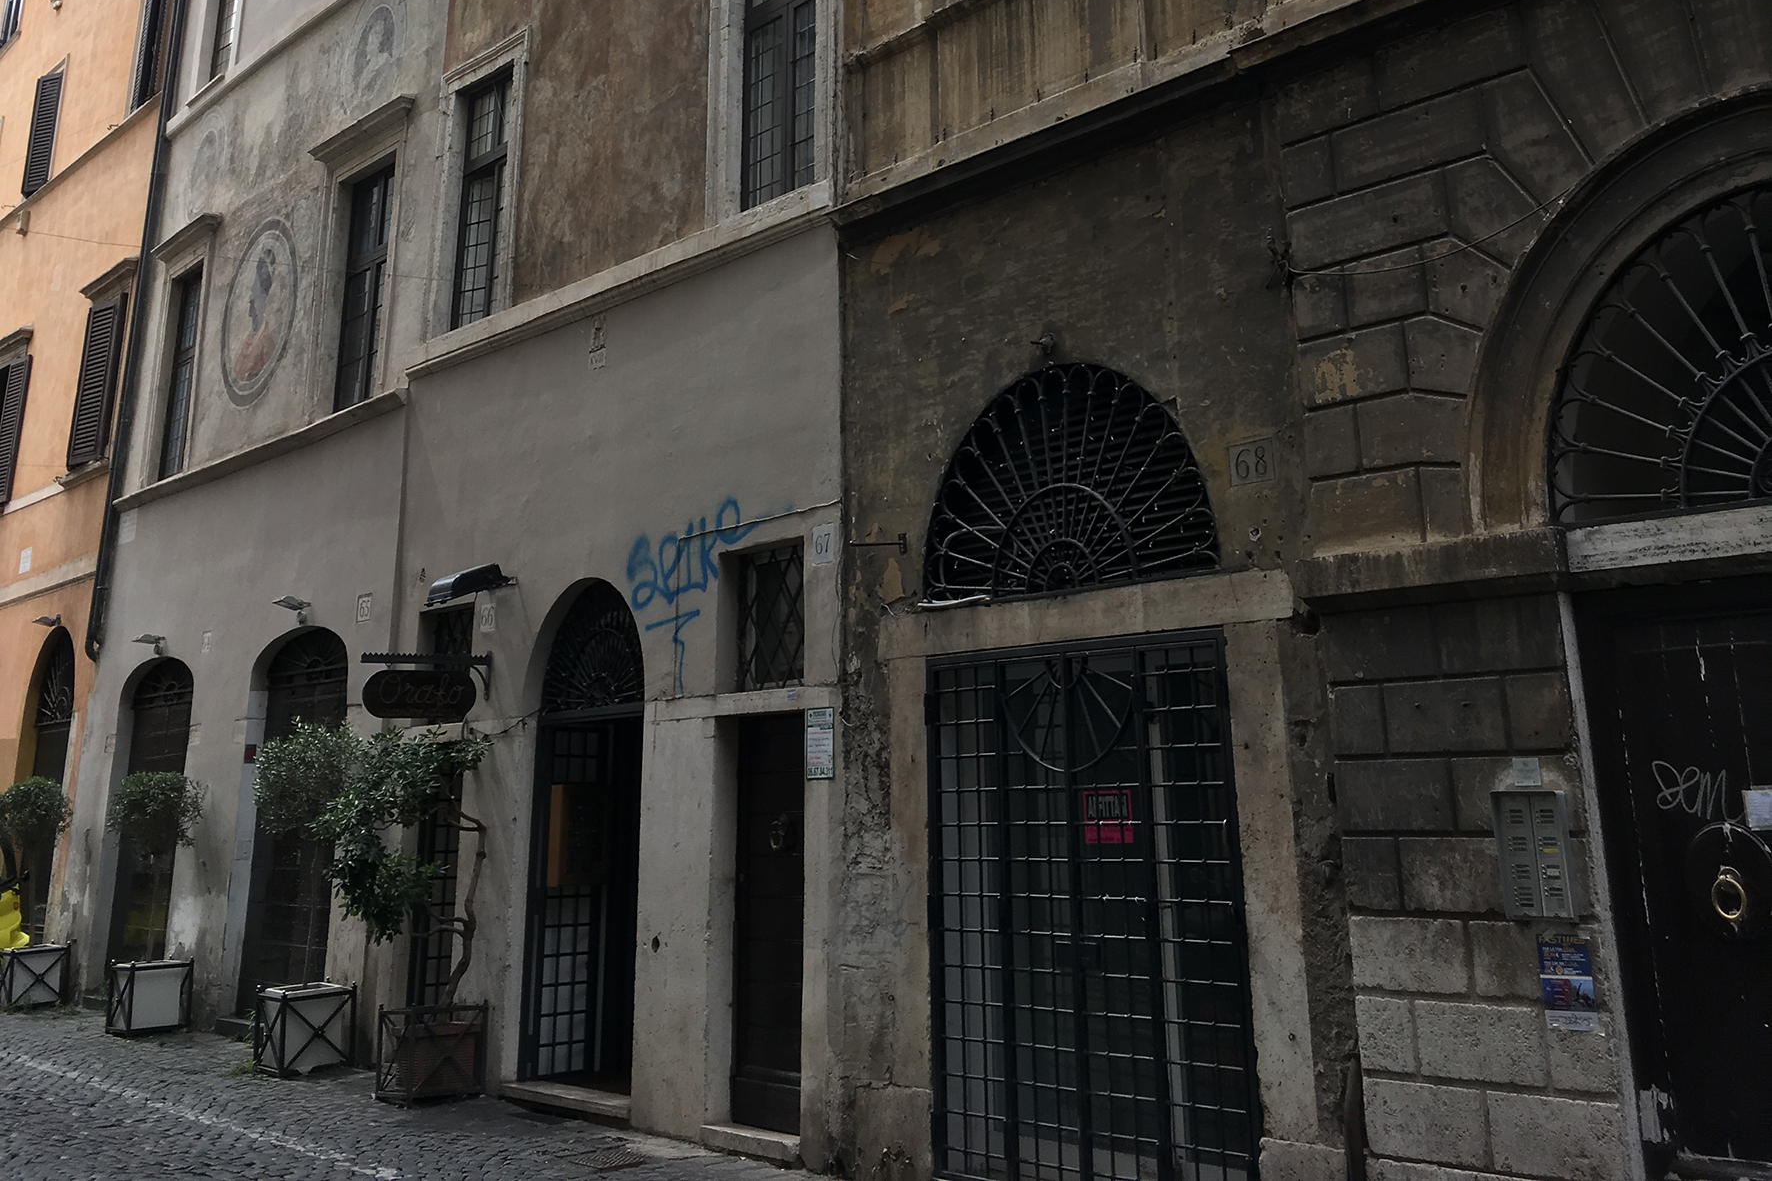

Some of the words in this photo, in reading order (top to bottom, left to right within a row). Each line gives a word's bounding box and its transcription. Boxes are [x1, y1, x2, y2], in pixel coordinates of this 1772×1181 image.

[1235, 445, 1268, 480] 68
[814, 532, 831, 555] 67
[359, 599, 371, 619] 65
[480, 606, 495, 627] 66
[379, 672, 466, 706] Orafo
[1538, 934, 1586, 945] FASTWEB
